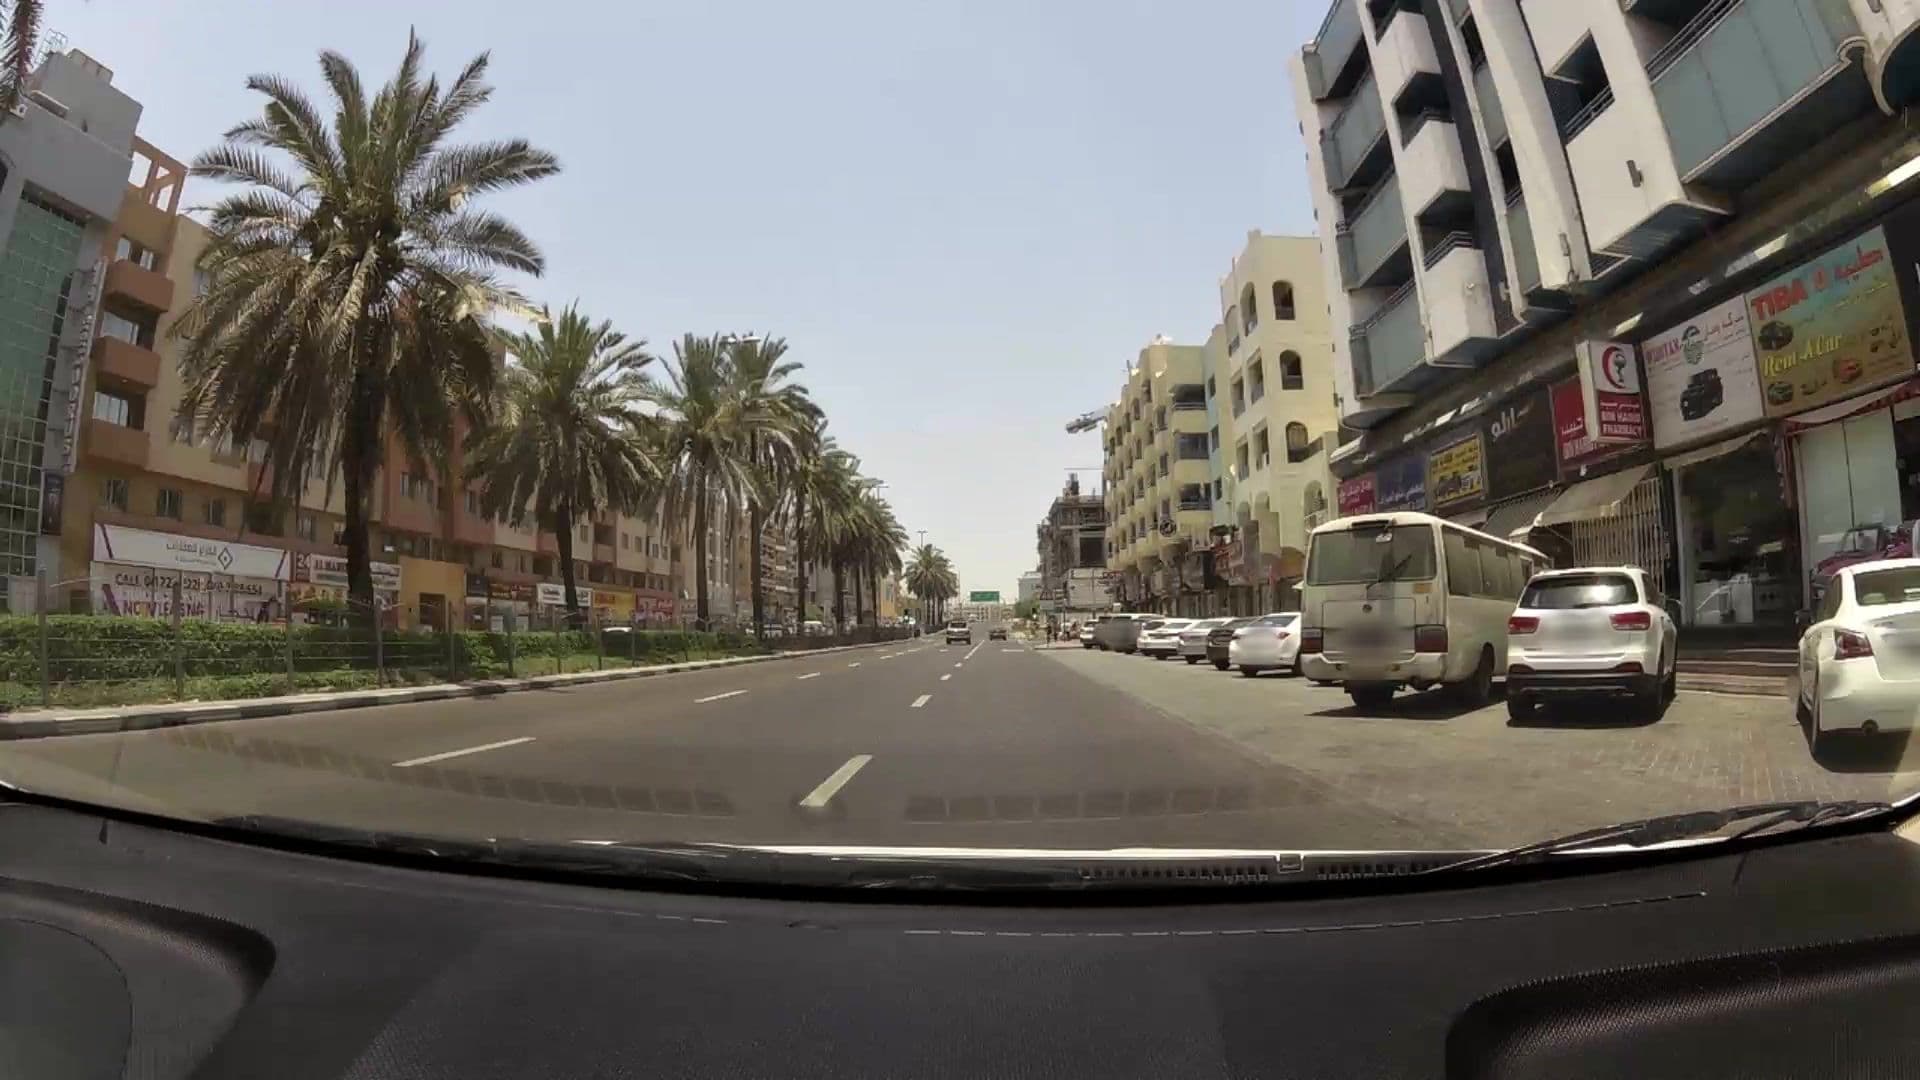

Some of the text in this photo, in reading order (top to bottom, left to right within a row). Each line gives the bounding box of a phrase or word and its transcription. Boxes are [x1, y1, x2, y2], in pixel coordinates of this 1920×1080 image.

[1751, 278, 1809, 320] TIBA
[1763, 351, 1797, 378] Rent
[1813, 334, 1842, 358] Car
